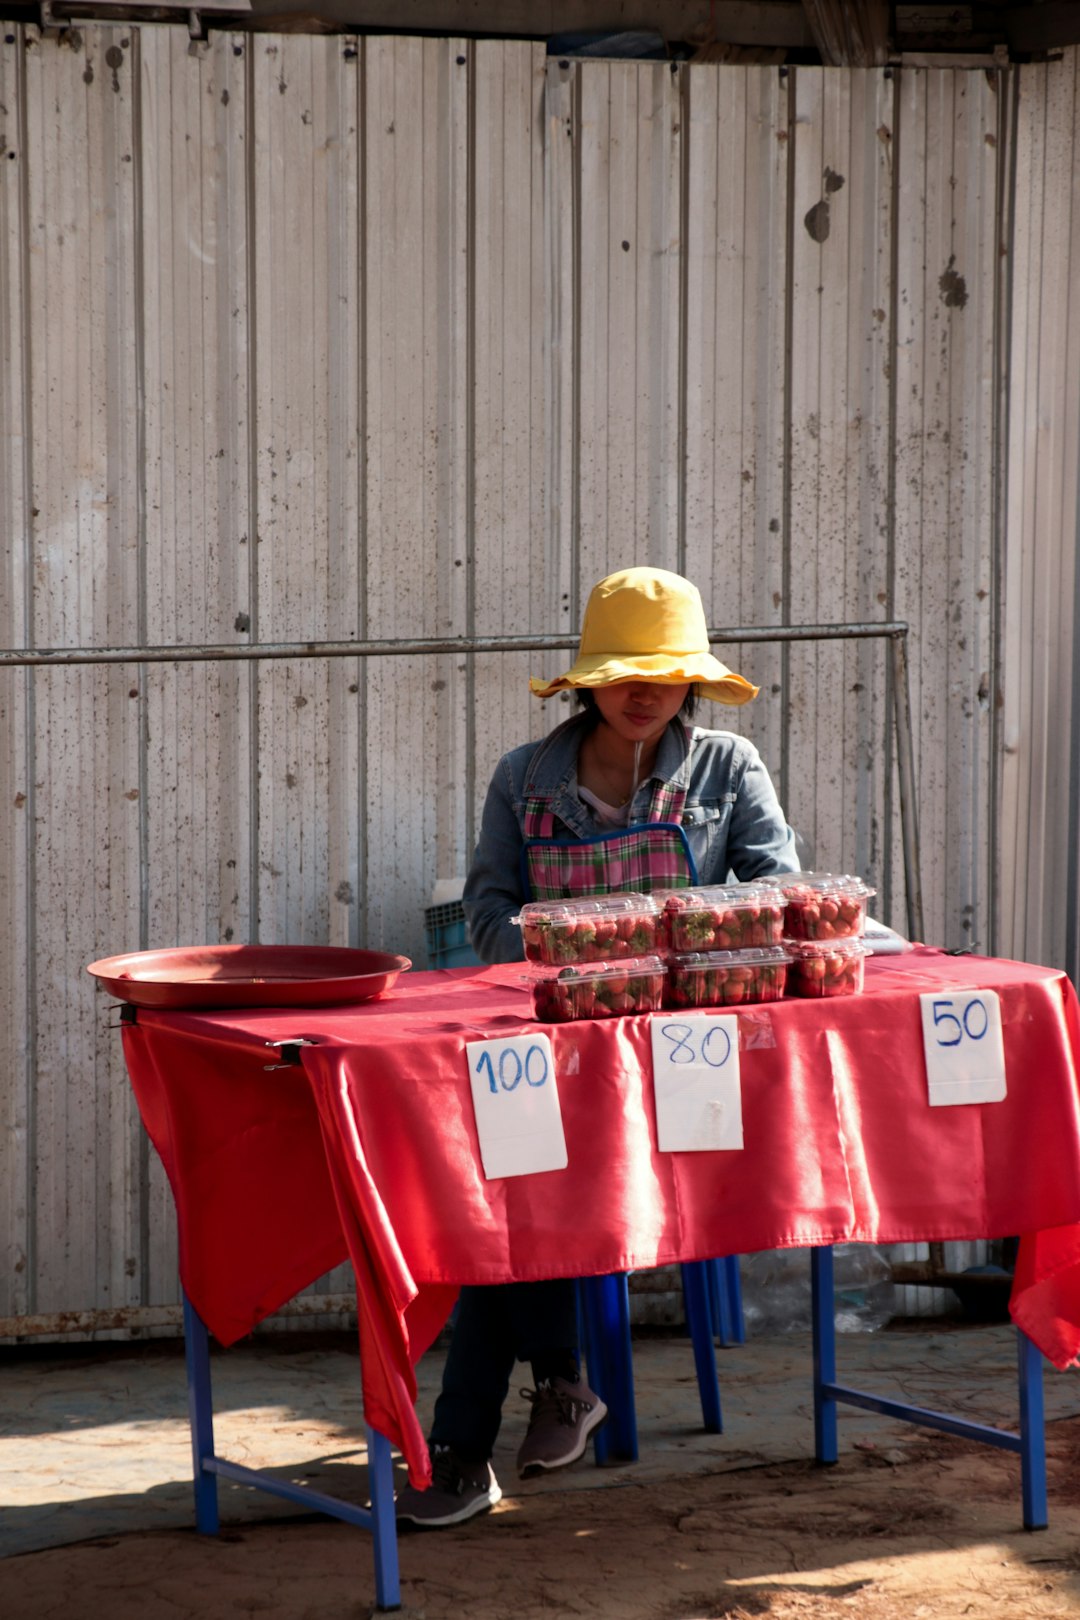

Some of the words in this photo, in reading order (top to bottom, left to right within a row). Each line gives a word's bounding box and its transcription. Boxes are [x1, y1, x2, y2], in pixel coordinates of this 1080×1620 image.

[661, 1024, 730, 1067] 80
[933, 999, 988, 1047] 50
[476, 1045, 548, 1093] 100
